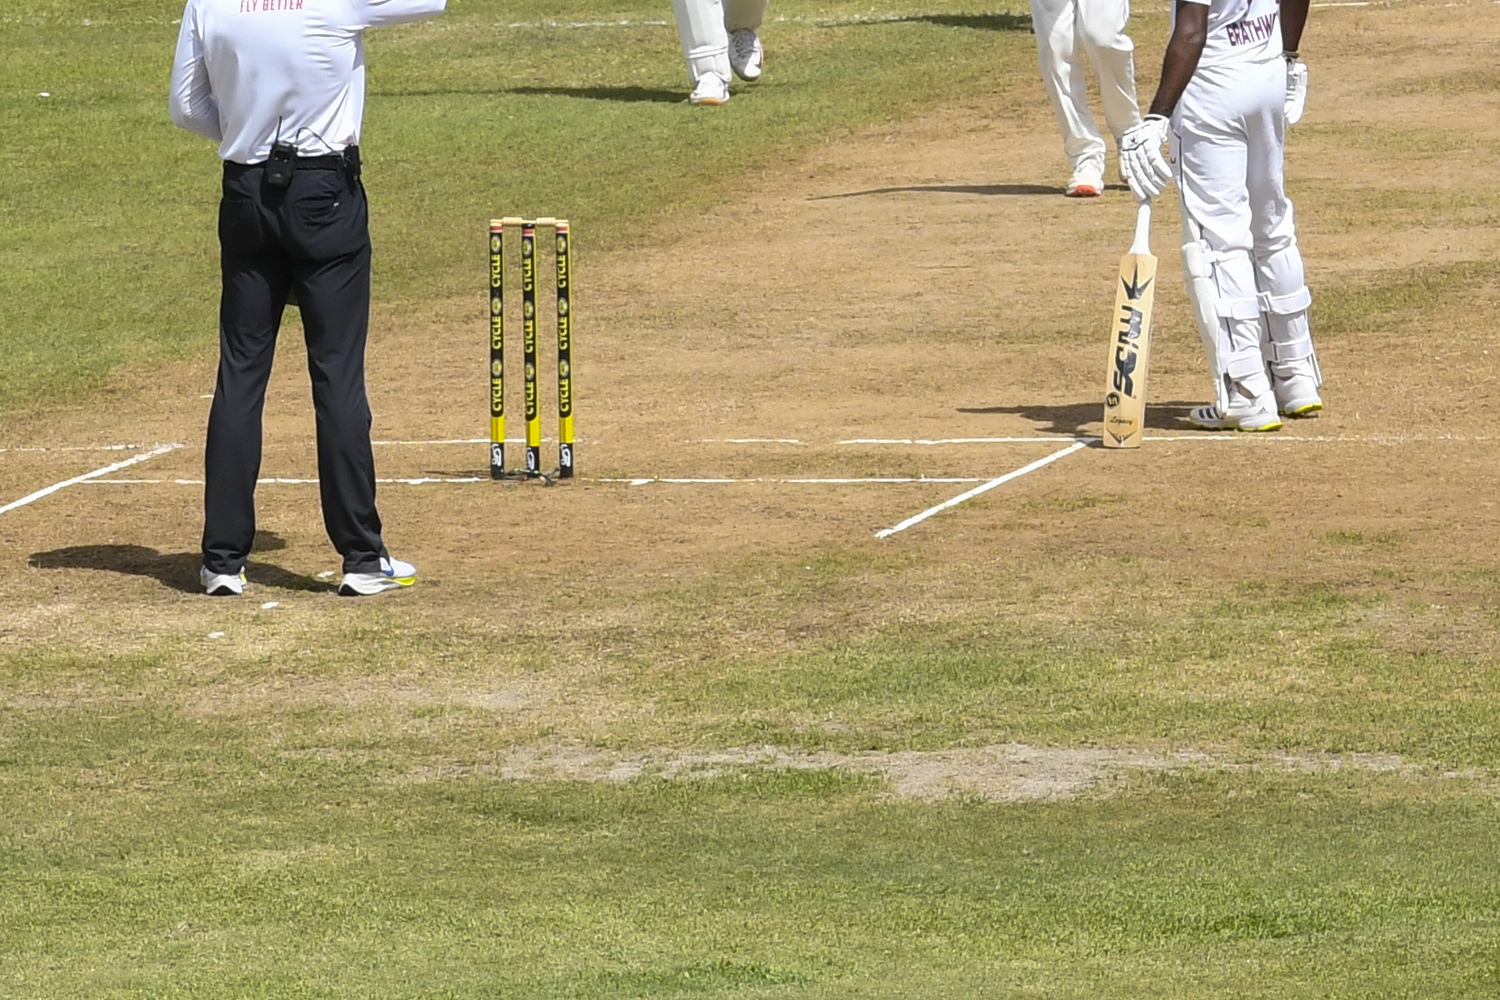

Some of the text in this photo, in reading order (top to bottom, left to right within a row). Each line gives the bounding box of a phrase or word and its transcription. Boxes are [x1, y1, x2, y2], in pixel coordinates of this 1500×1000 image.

[240, 0, 258, 13] FLY
[491, 253, 500, 288] CYCLE
[523, 258, 532, 292] CYCLE
[557, 254, 566, 288] CYCLE
[492, 316, 502, 350] CYCLE
[525, 320, 534, 353] CYCLE
[558, 316, 568, 350] CYCLE
[492, 378, 502, 412] CYCLE
[525, 381, 535, 415] CYCLE
[559, 378, 569, 412] CYCLE
